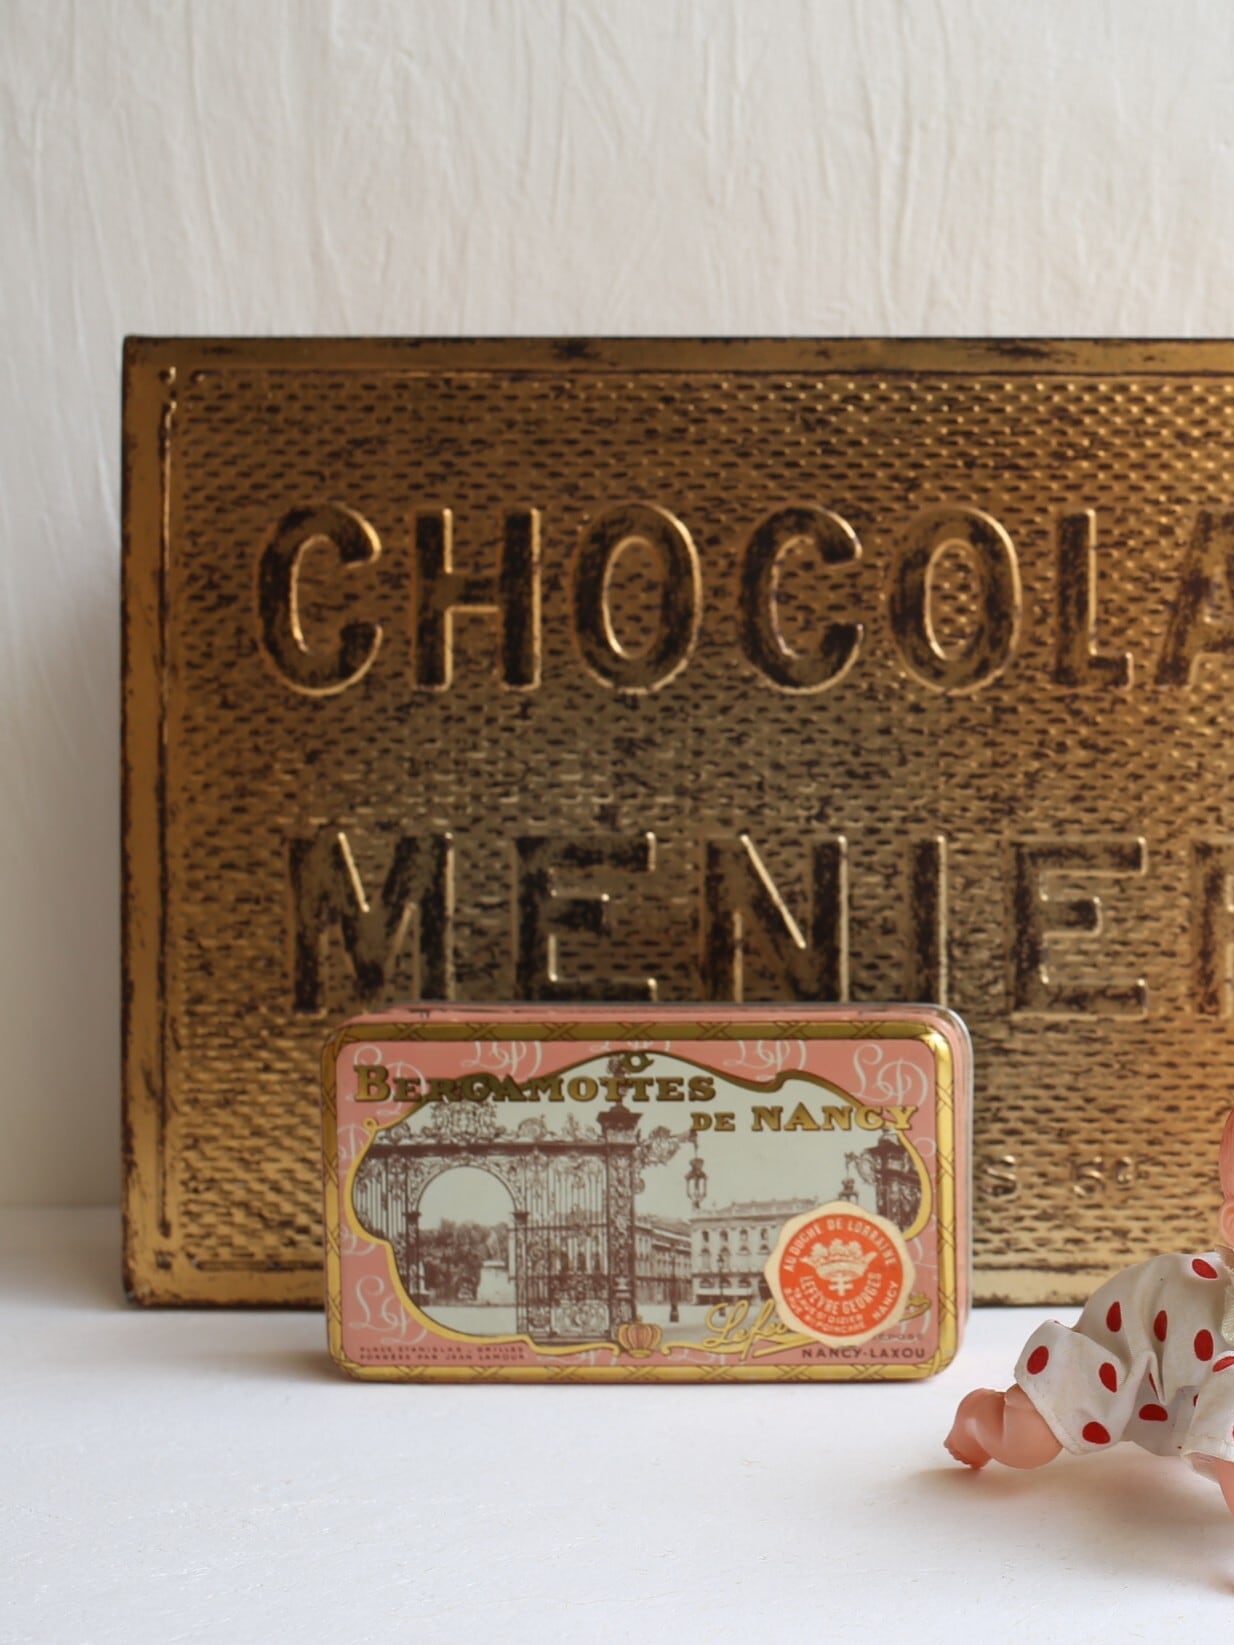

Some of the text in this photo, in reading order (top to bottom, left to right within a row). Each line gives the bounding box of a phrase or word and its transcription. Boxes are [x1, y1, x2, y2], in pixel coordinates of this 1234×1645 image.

[353, 1065, 717, 1103] BERGAMOTTES
[690, 1101, 919, 1132] DE NANCY
[847, 1219, 898, 1266] LORRAINE
[871, 1280, 900, 1320] NANCY
[801, 1348, 926, 1359] NANCY-LAXOU
